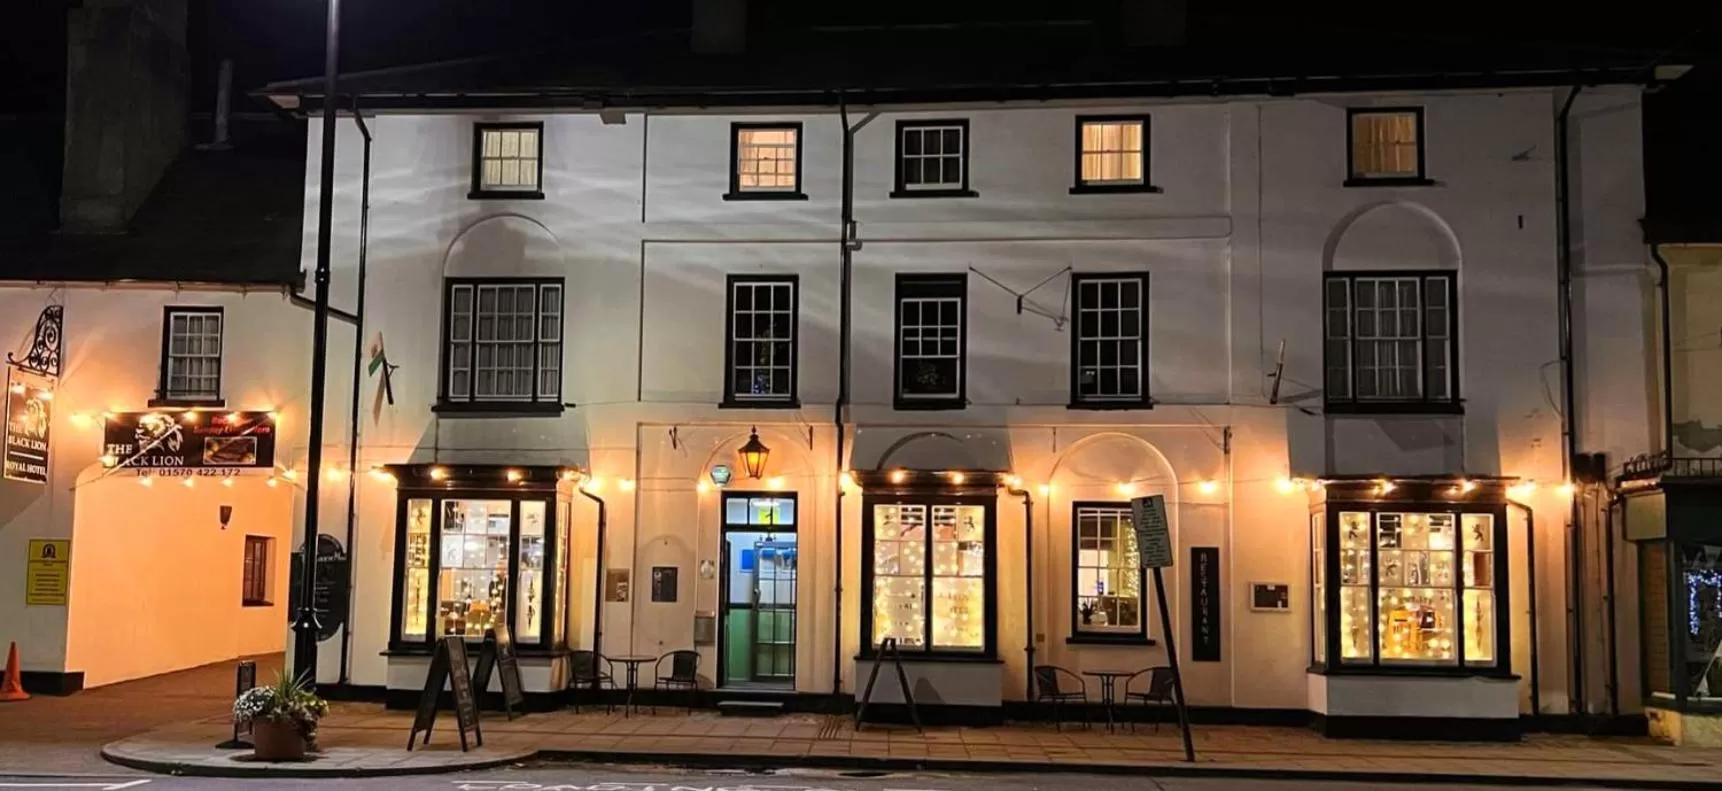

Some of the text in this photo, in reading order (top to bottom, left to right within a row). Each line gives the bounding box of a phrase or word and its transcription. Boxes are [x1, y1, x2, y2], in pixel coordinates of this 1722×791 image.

[9, 436, 47, 451] BLACK LION
[107, 443, 133, 455] THE
[152, 455, 184, 466] LION
[7, 460, 47, 475] ROYAL HOTEL
[159, 468, 192, 477] 01570
[1200, 551, 1209, 645] RESTAURANT
